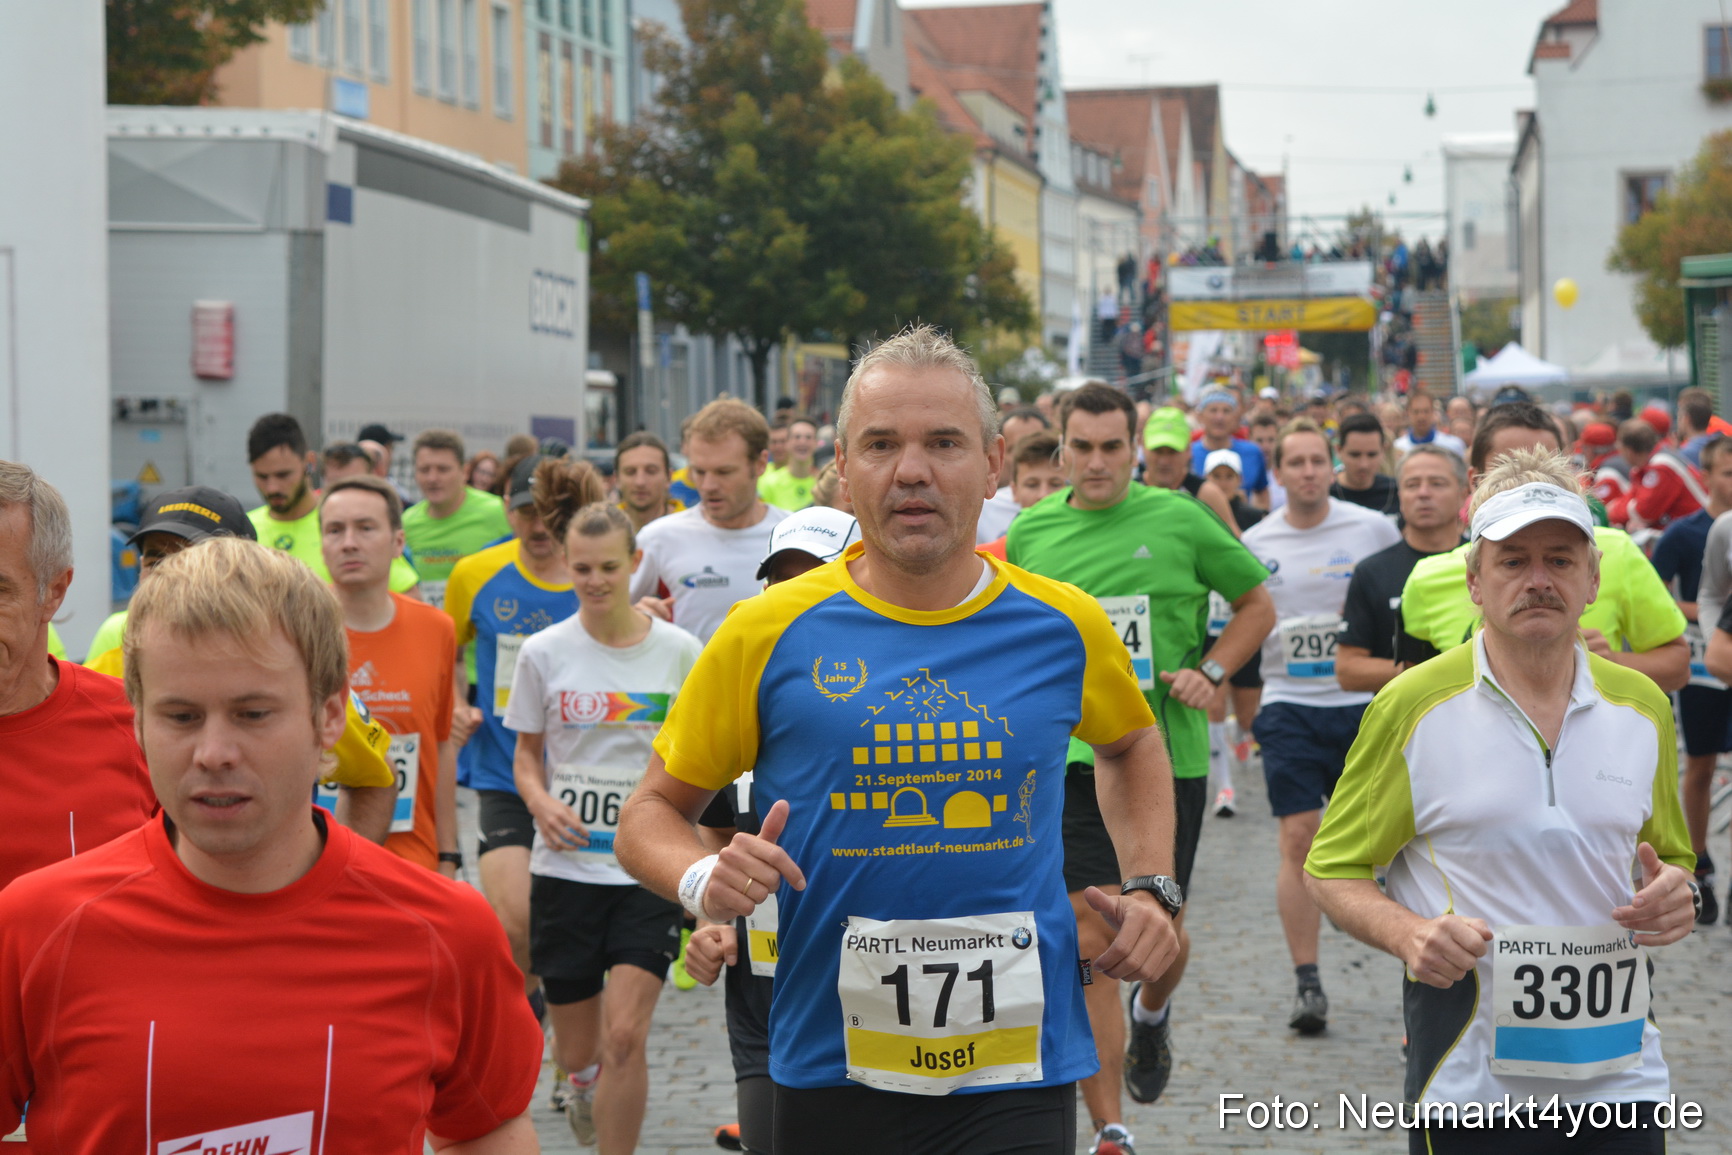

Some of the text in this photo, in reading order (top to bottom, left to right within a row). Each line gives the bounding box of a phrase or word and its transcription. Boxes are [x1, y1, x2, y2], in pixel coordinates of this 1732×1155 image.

[1238, 306, 1305, 322] START
[833, 662, 847, 671] 15
[823, 674, 856, 683] Jahre
[358, 689, 411, 702] Scheck
[855, 769, 1002, 787] 21.September 2014
[832, 836, 1024, 857] www.stadtlauf-neumarkt.de
[767, 938, 779, 958] W
[847, 934, 1004, 954] PARTL Neumarkt
[1499, 938, 1627, 956] PARTL Neumarkt
[881, 959, 995, 1028] 171
[1512, 957, 1637, 1021] 3307
[852, 1016, 859, 1026] B
[910, 1042, 975, 1071] Josef
